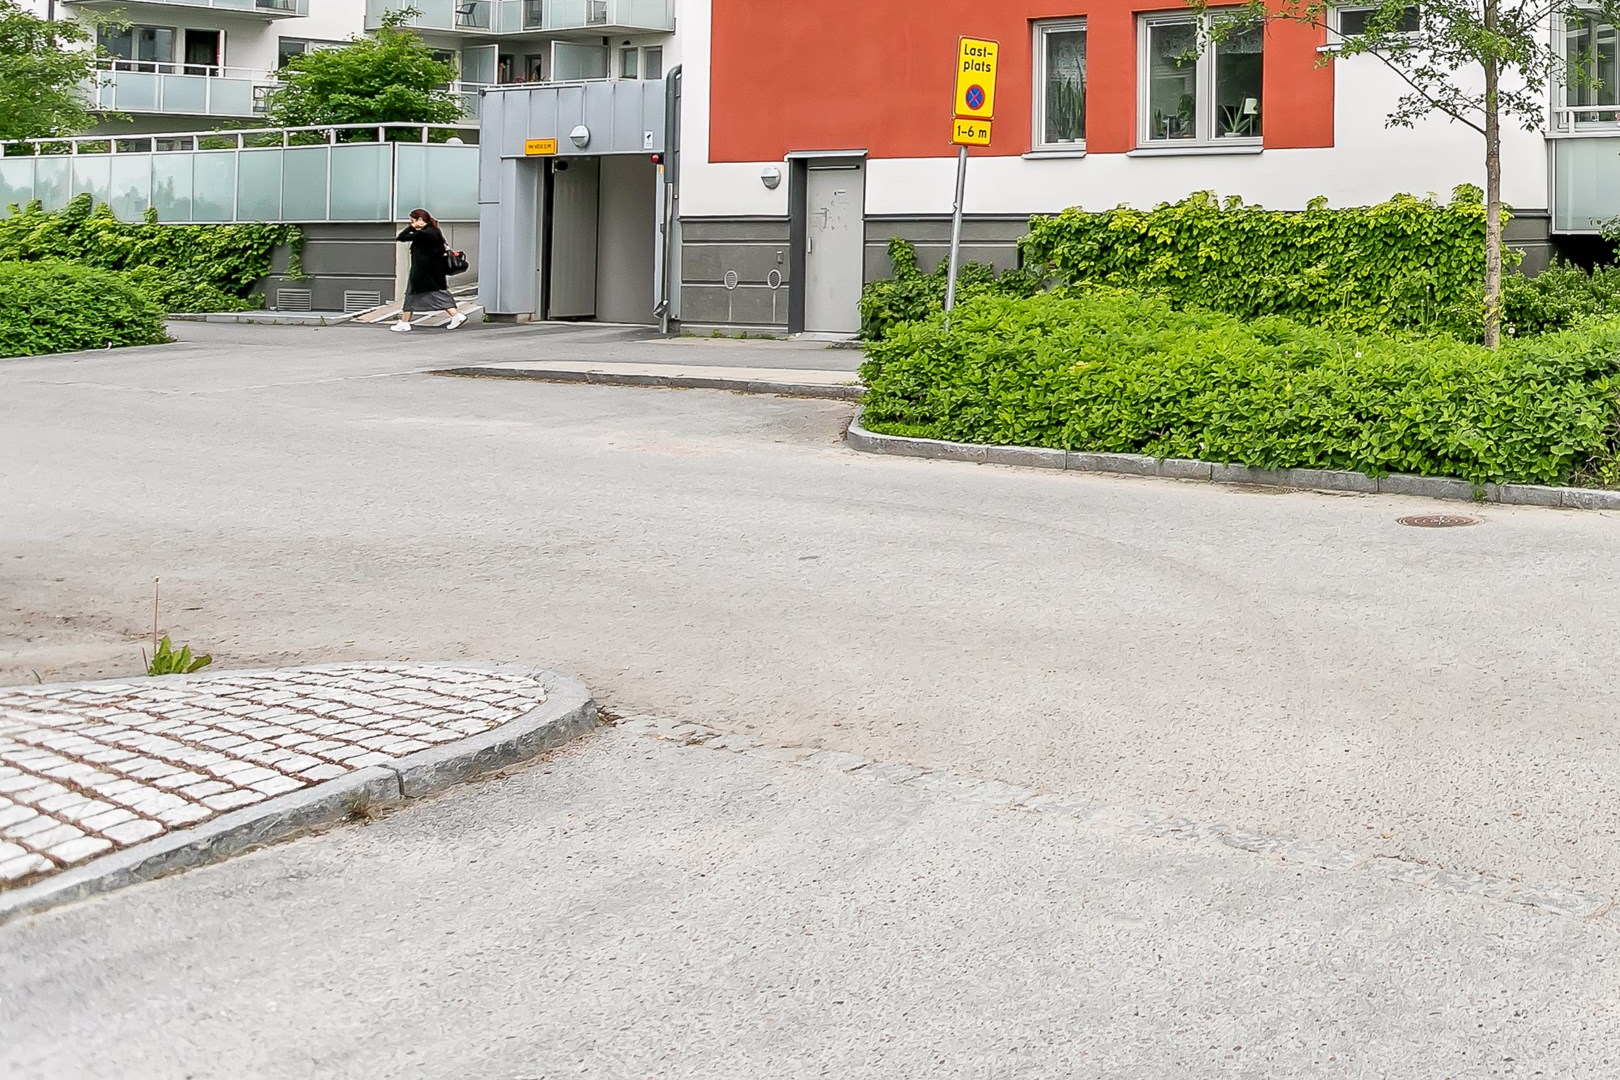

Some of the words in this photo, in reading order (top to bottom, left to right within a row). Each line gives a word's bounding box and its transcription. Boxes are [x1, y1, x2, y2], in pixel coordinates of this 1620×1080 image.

[964, 43, 993, 57] Last-
[963, 59, 991, 72] plats
[957, 125, 974, 137] 1-6
[978, 129, 987, 138] m
